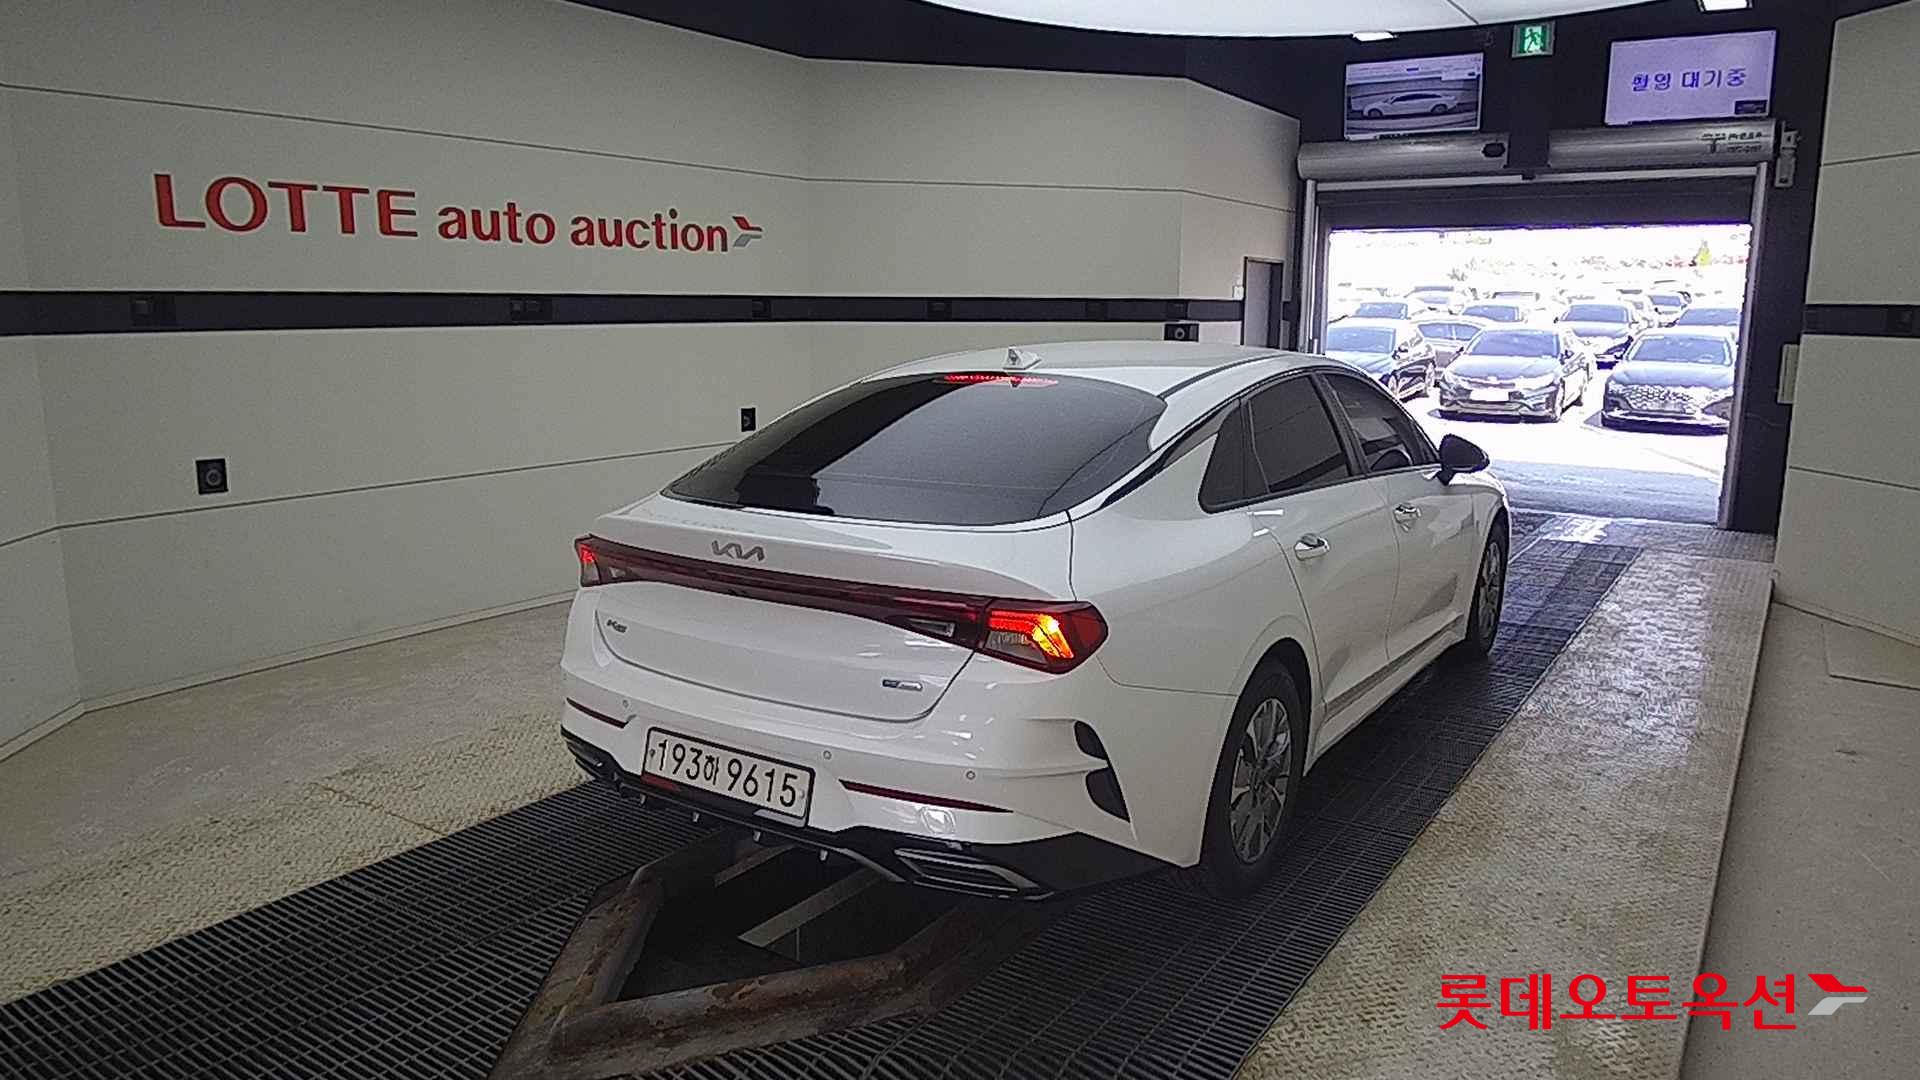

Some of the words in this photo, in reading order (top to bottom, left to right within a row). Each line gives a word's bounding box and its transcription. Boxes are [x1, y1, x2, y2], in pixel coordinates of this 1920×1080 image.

[153, 172, 418, 238] LOTTE
[437, 202, 556, 245] auto
[570, 208, 729, 252] auction
[727, 758, 798, 808] 9615
